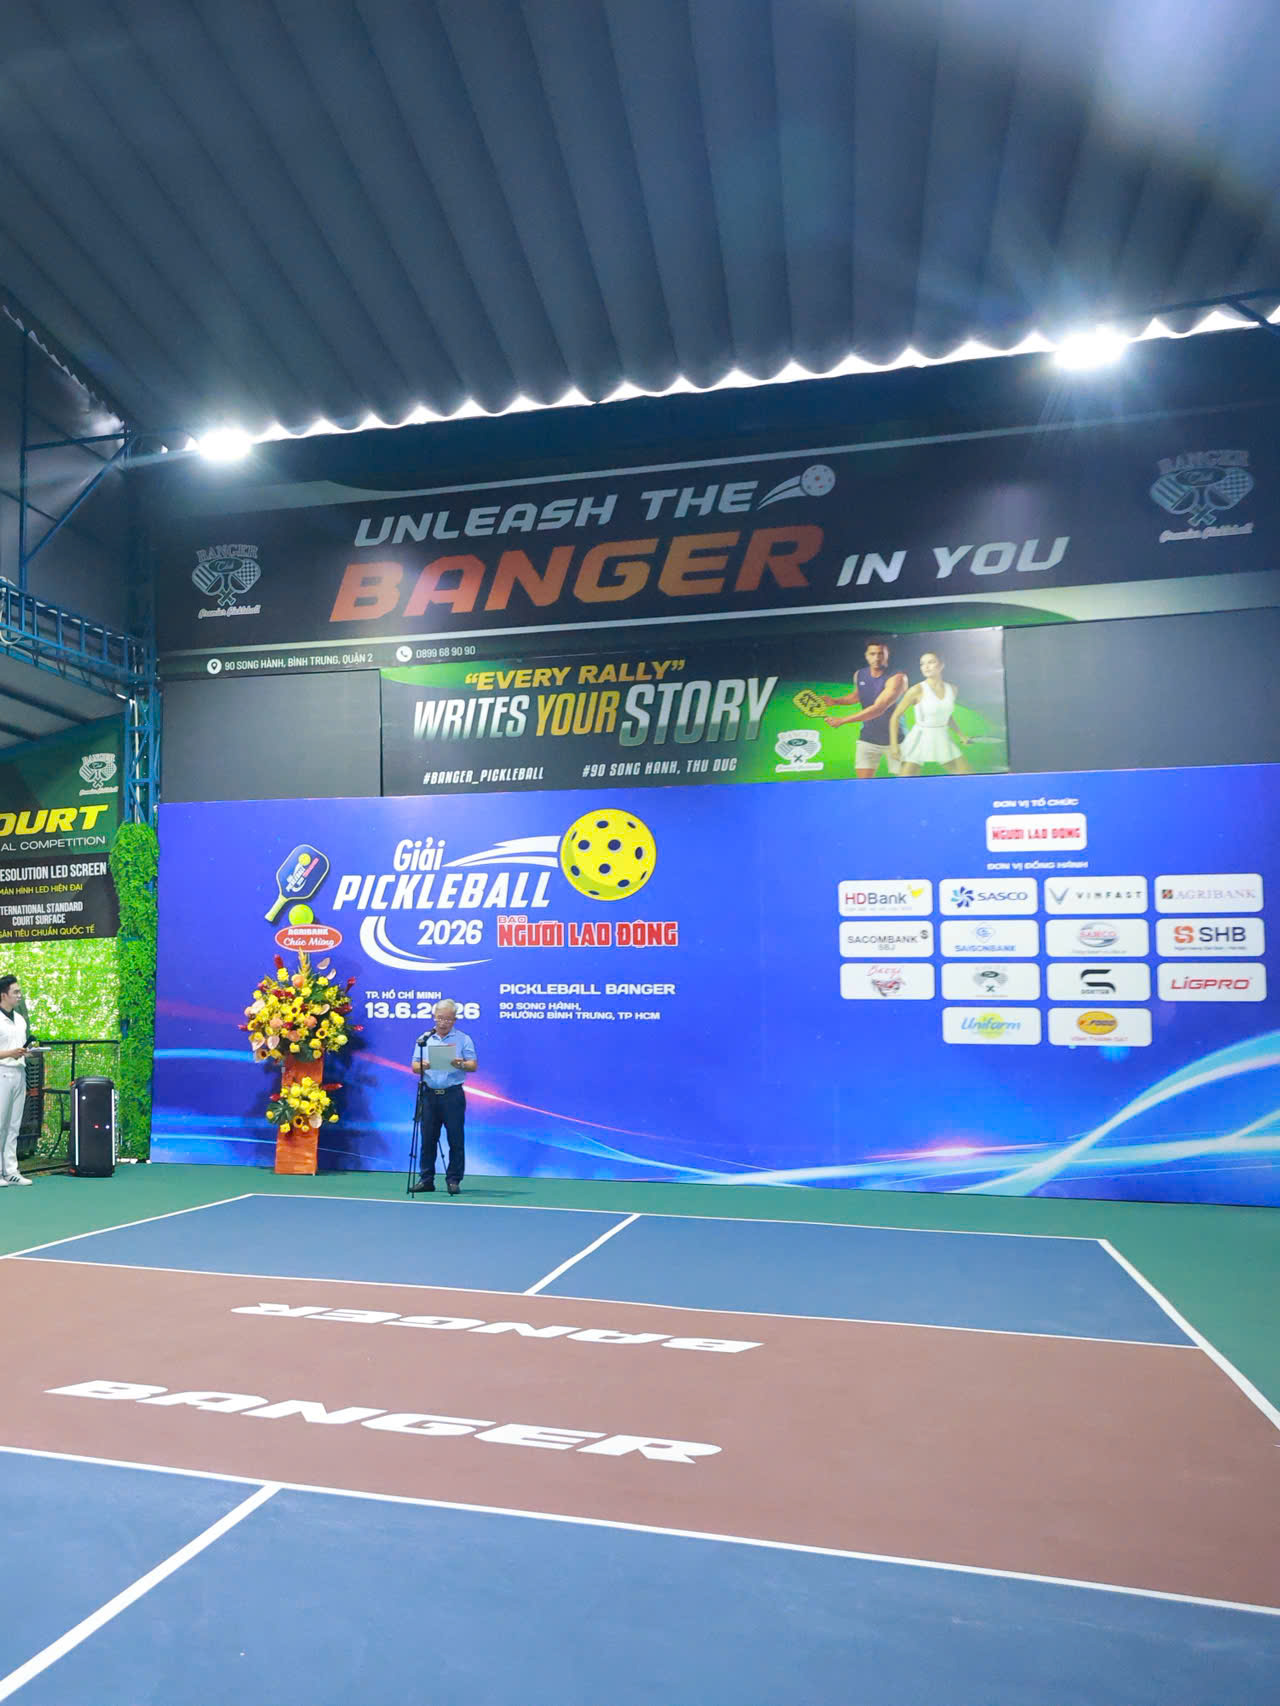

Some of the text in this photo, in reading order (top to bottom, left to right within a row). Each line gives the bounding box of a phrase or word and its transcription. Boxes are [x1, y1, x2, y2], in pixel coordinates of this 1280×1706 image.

[354, 480, 758, 547] UNLEASH THE
[836, 536, 1070, 587] IN YOU
[329, 525, 824, 622] BANGER
[416, 646, 476, 659] 0899 68 90 90
[225, 661, 235, 670] 90
[236, 660, 259, 670] SONG
[288, 656, 308, 667] BÌNH
[342, 652, 366, 665] QUẬN
[368, 653, 374, 662] 2
[413, 676, 779, 747] WRITES YOUR STORY
[423, 767, 544, 785] #BANGER_PICKLEBALL
[582, 763, 606, 778] #90
[610, 762, 643, 776] SONG
[645, 760, 681, 775] HANH,
[687, 759, 711, 773] THU
[19, 836, 106, 850] COMPETITION
[393, 836, 446, 872] Giải
[50, 865, 69, 878] LED
[70, 862, 107, 877] SCREEN
[35, 885, 50, 893] LED
[332, 872, 552, 910] PICKLEBALL
[977, 892, 1028, 902] SASCO
[1076, 891, 1142, 899] VINFAST
[1175, 888, 1256, 899] AGRIBANK
[845, 892, 907, 905] HDBank
[46, 901, 83, 913] STANDARD
[12, 913, 66, 926] COURT SURFACE
[416, 919, 484, 946] 2026
[498, 920, 677, 948] NGƯỜI LAO ĐỘNG
[848, 935, 918, 944] SACOMBANK
[1199, 926, 1247, 942] SHB
[365, 990, 380, 999] TP.
[397, 989, 414, 999] CHÍ
[416, 991, 442, 999] MINH
[499, 983, 676, 995] PICKLEBALL BANGER
[499, 1002, 514, 1010] 90
[515, 1002, 546, 1010] SONG
[546, 1010, 573, 1019] BÌNH
[575, 1011, 616, 1020] TRUNG,
[617, 1012, 633, 1020] TP
[634, 1012, 661, 1020] HCM
[231, 1302, 766, 1354] BANGER
[43, 1379, 723, 1464] BANGER
